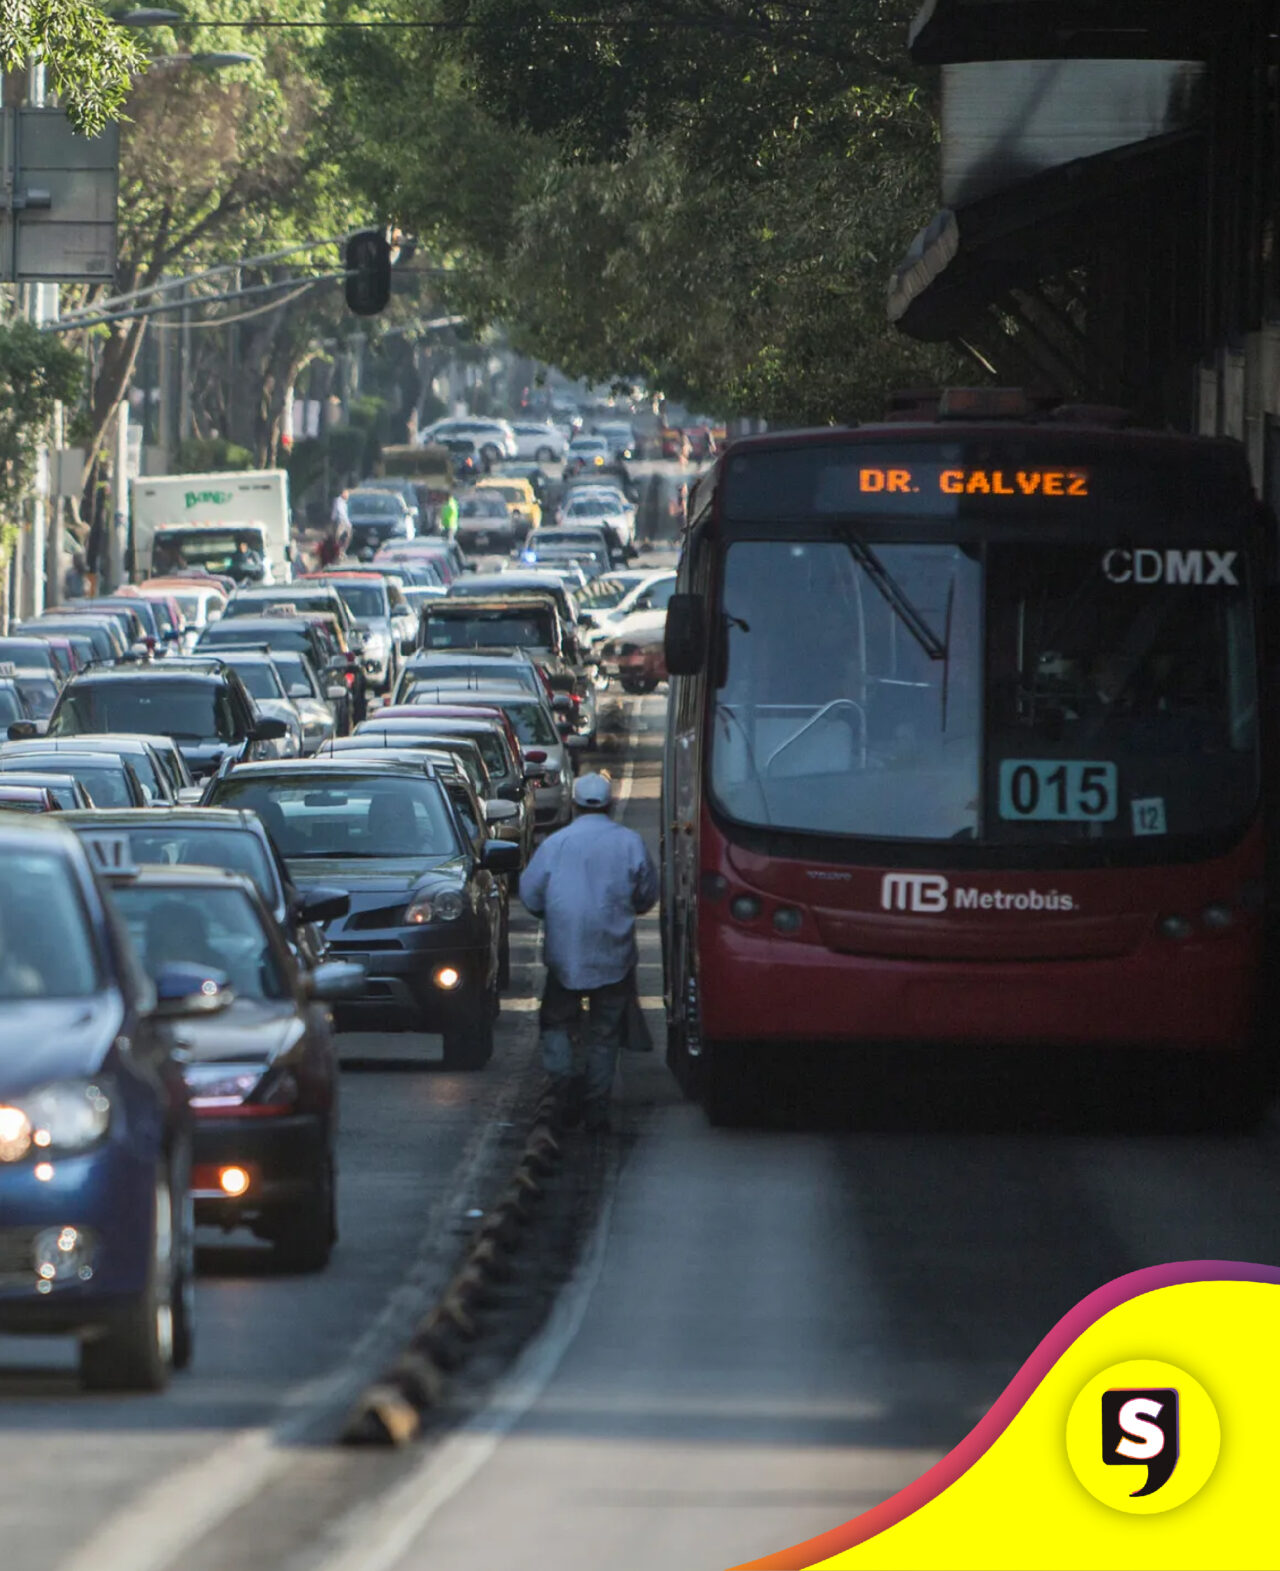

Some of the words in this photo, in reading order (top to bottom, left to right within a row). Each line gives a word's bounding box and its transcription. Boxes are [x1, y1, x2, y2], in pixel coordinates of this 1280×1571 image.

[859, 468, 919, 492] DR.
[939, 470, 1088, 495] GALVEZ
[1102, 548, 1239, 585] CDMX
[1011, 765, 1108, 815] 015
[954, 888, 1074, 911] Metrobús
